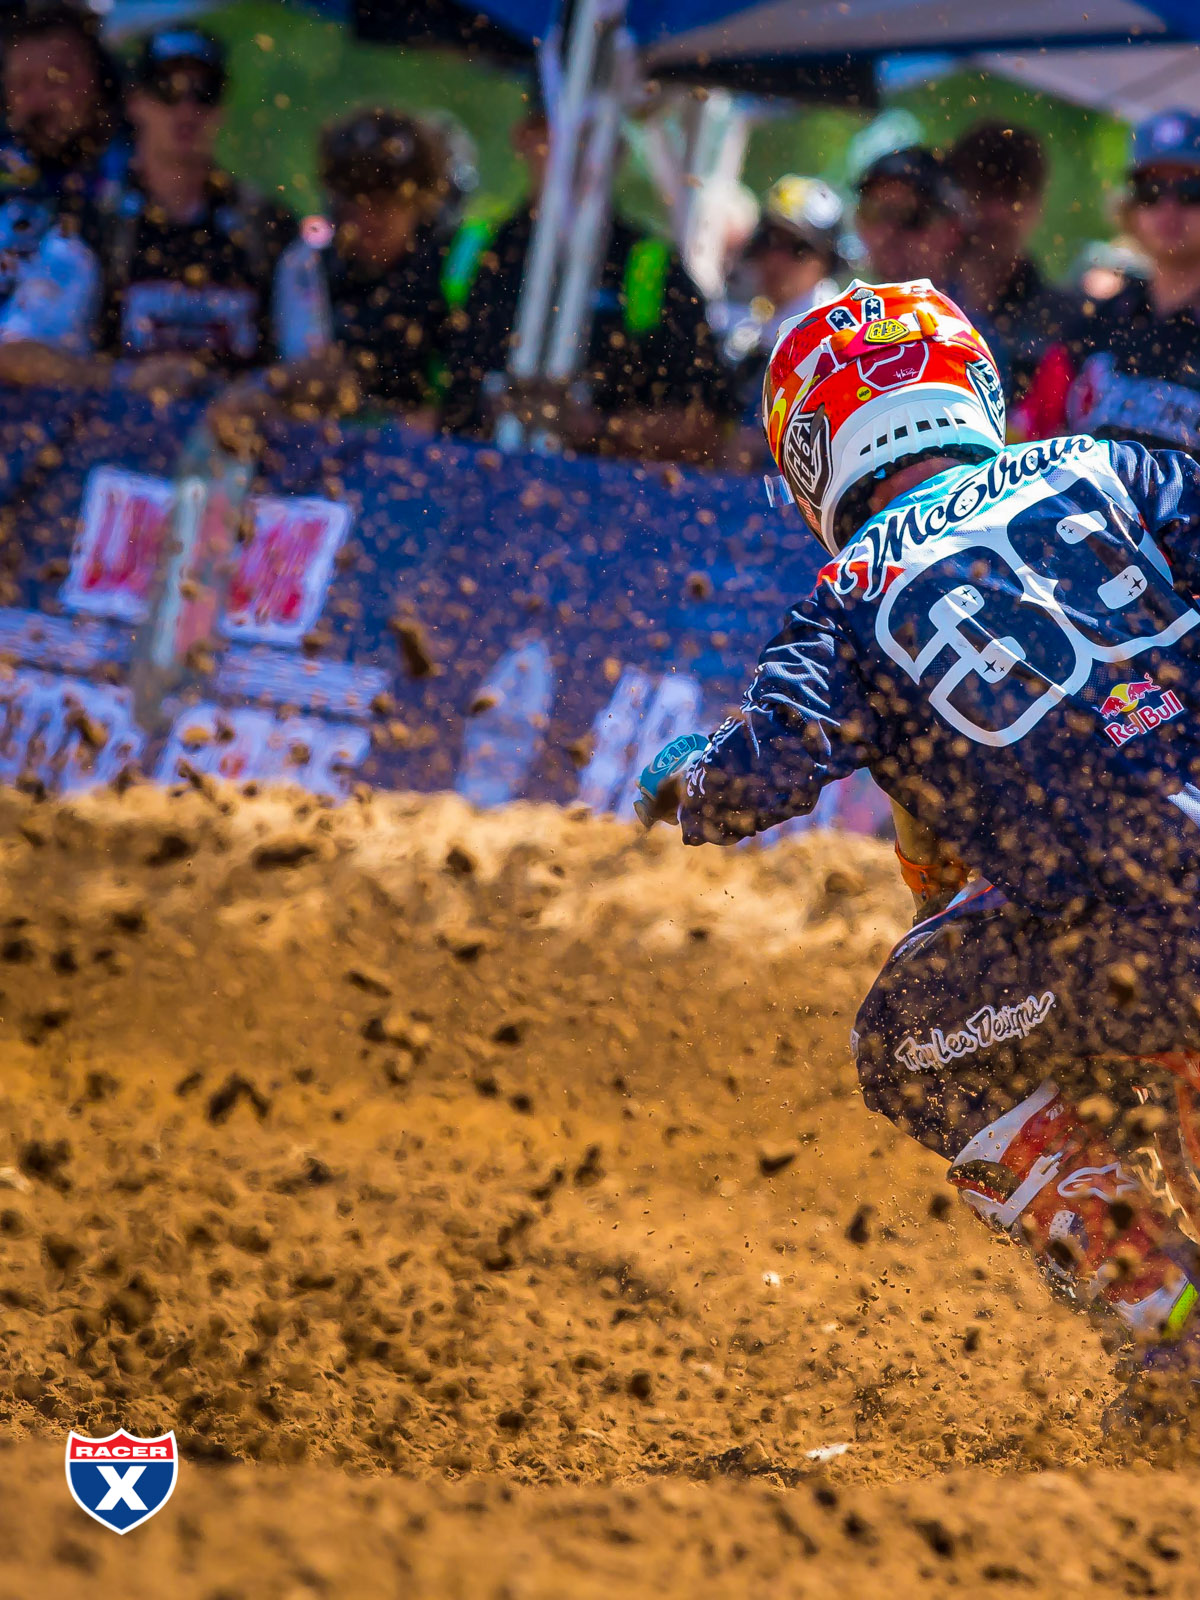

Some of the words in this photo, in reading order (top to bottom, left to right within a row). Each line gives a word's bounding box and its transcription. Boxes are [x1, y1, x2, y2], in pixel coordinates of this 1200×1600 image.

[1104, 712, 1147, 747] Red
[1137, 690, 1184, 730] Bull
[932, 1029, 977, 1063] Lee
